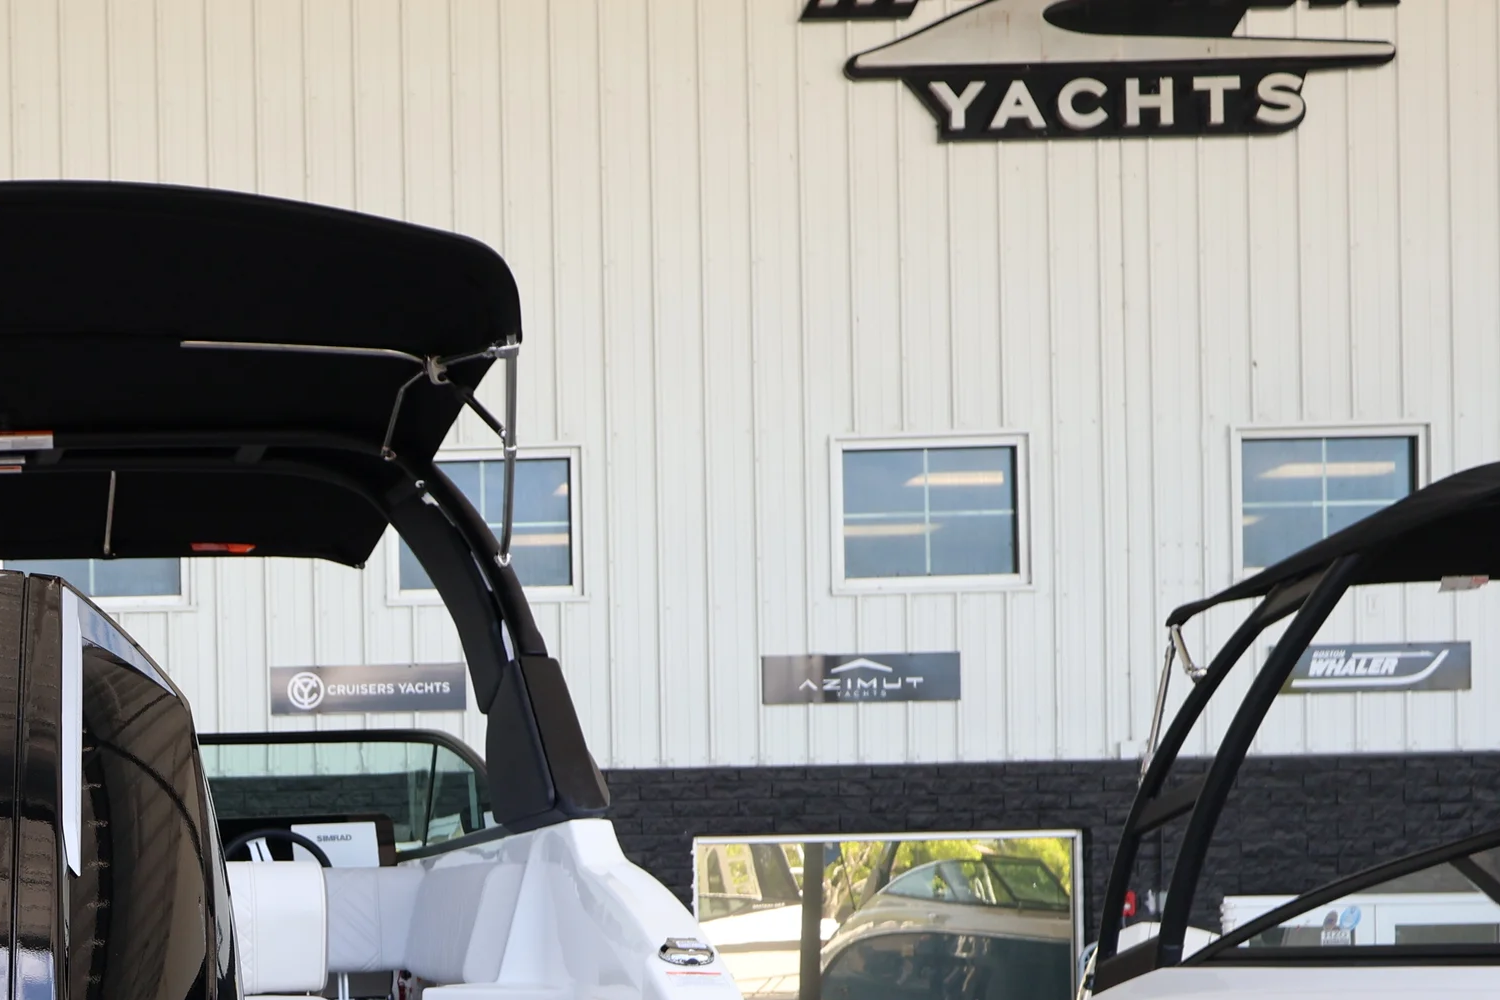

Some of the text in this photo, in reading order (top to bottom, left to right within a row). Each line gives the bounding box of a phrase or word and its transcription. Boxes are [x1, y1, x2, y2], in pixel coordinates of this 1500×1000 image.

[928, 72, 1305, 131] YACHTS
[1312, 649, 1346, 658] BOSTON
[1308, 657, 1398, 677] WHALER
[327, 681, 451, 696] CRUISERS YACHTS
[799, 676, 924, 692] AZIMUT
[837, 690, 887, 698] YACHTS
[316, 834, 353, 842] SIMRAD
